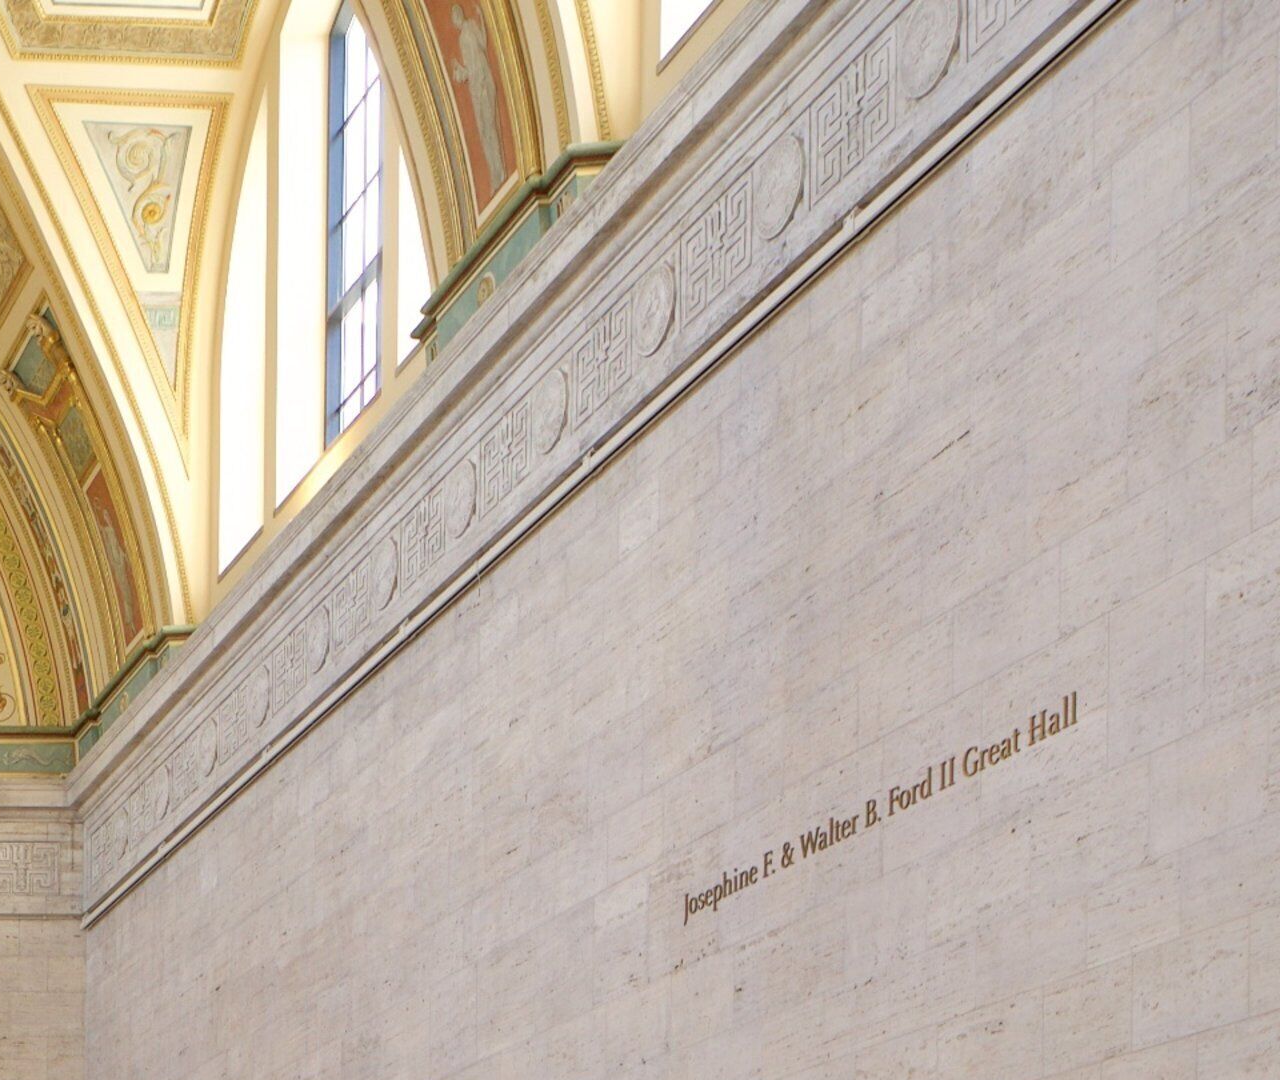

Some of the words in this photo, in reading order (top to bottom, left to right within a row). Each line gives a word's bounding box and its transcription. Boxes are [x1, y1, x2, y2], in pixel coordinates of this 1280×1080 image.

[682, 865, 758, 926] Josephine
[762, 850, 776, 878] F.
[780, 841, 795, 869] &
[799, 812, 859, 859] Walter
[865, 799, 881, 828] B.
[888, 766, 933, 817] Ford
[939, 756, 956, 792] II
[962, 728, 1020, 778] Great
[1028, 692, 1077, 746] Hall
